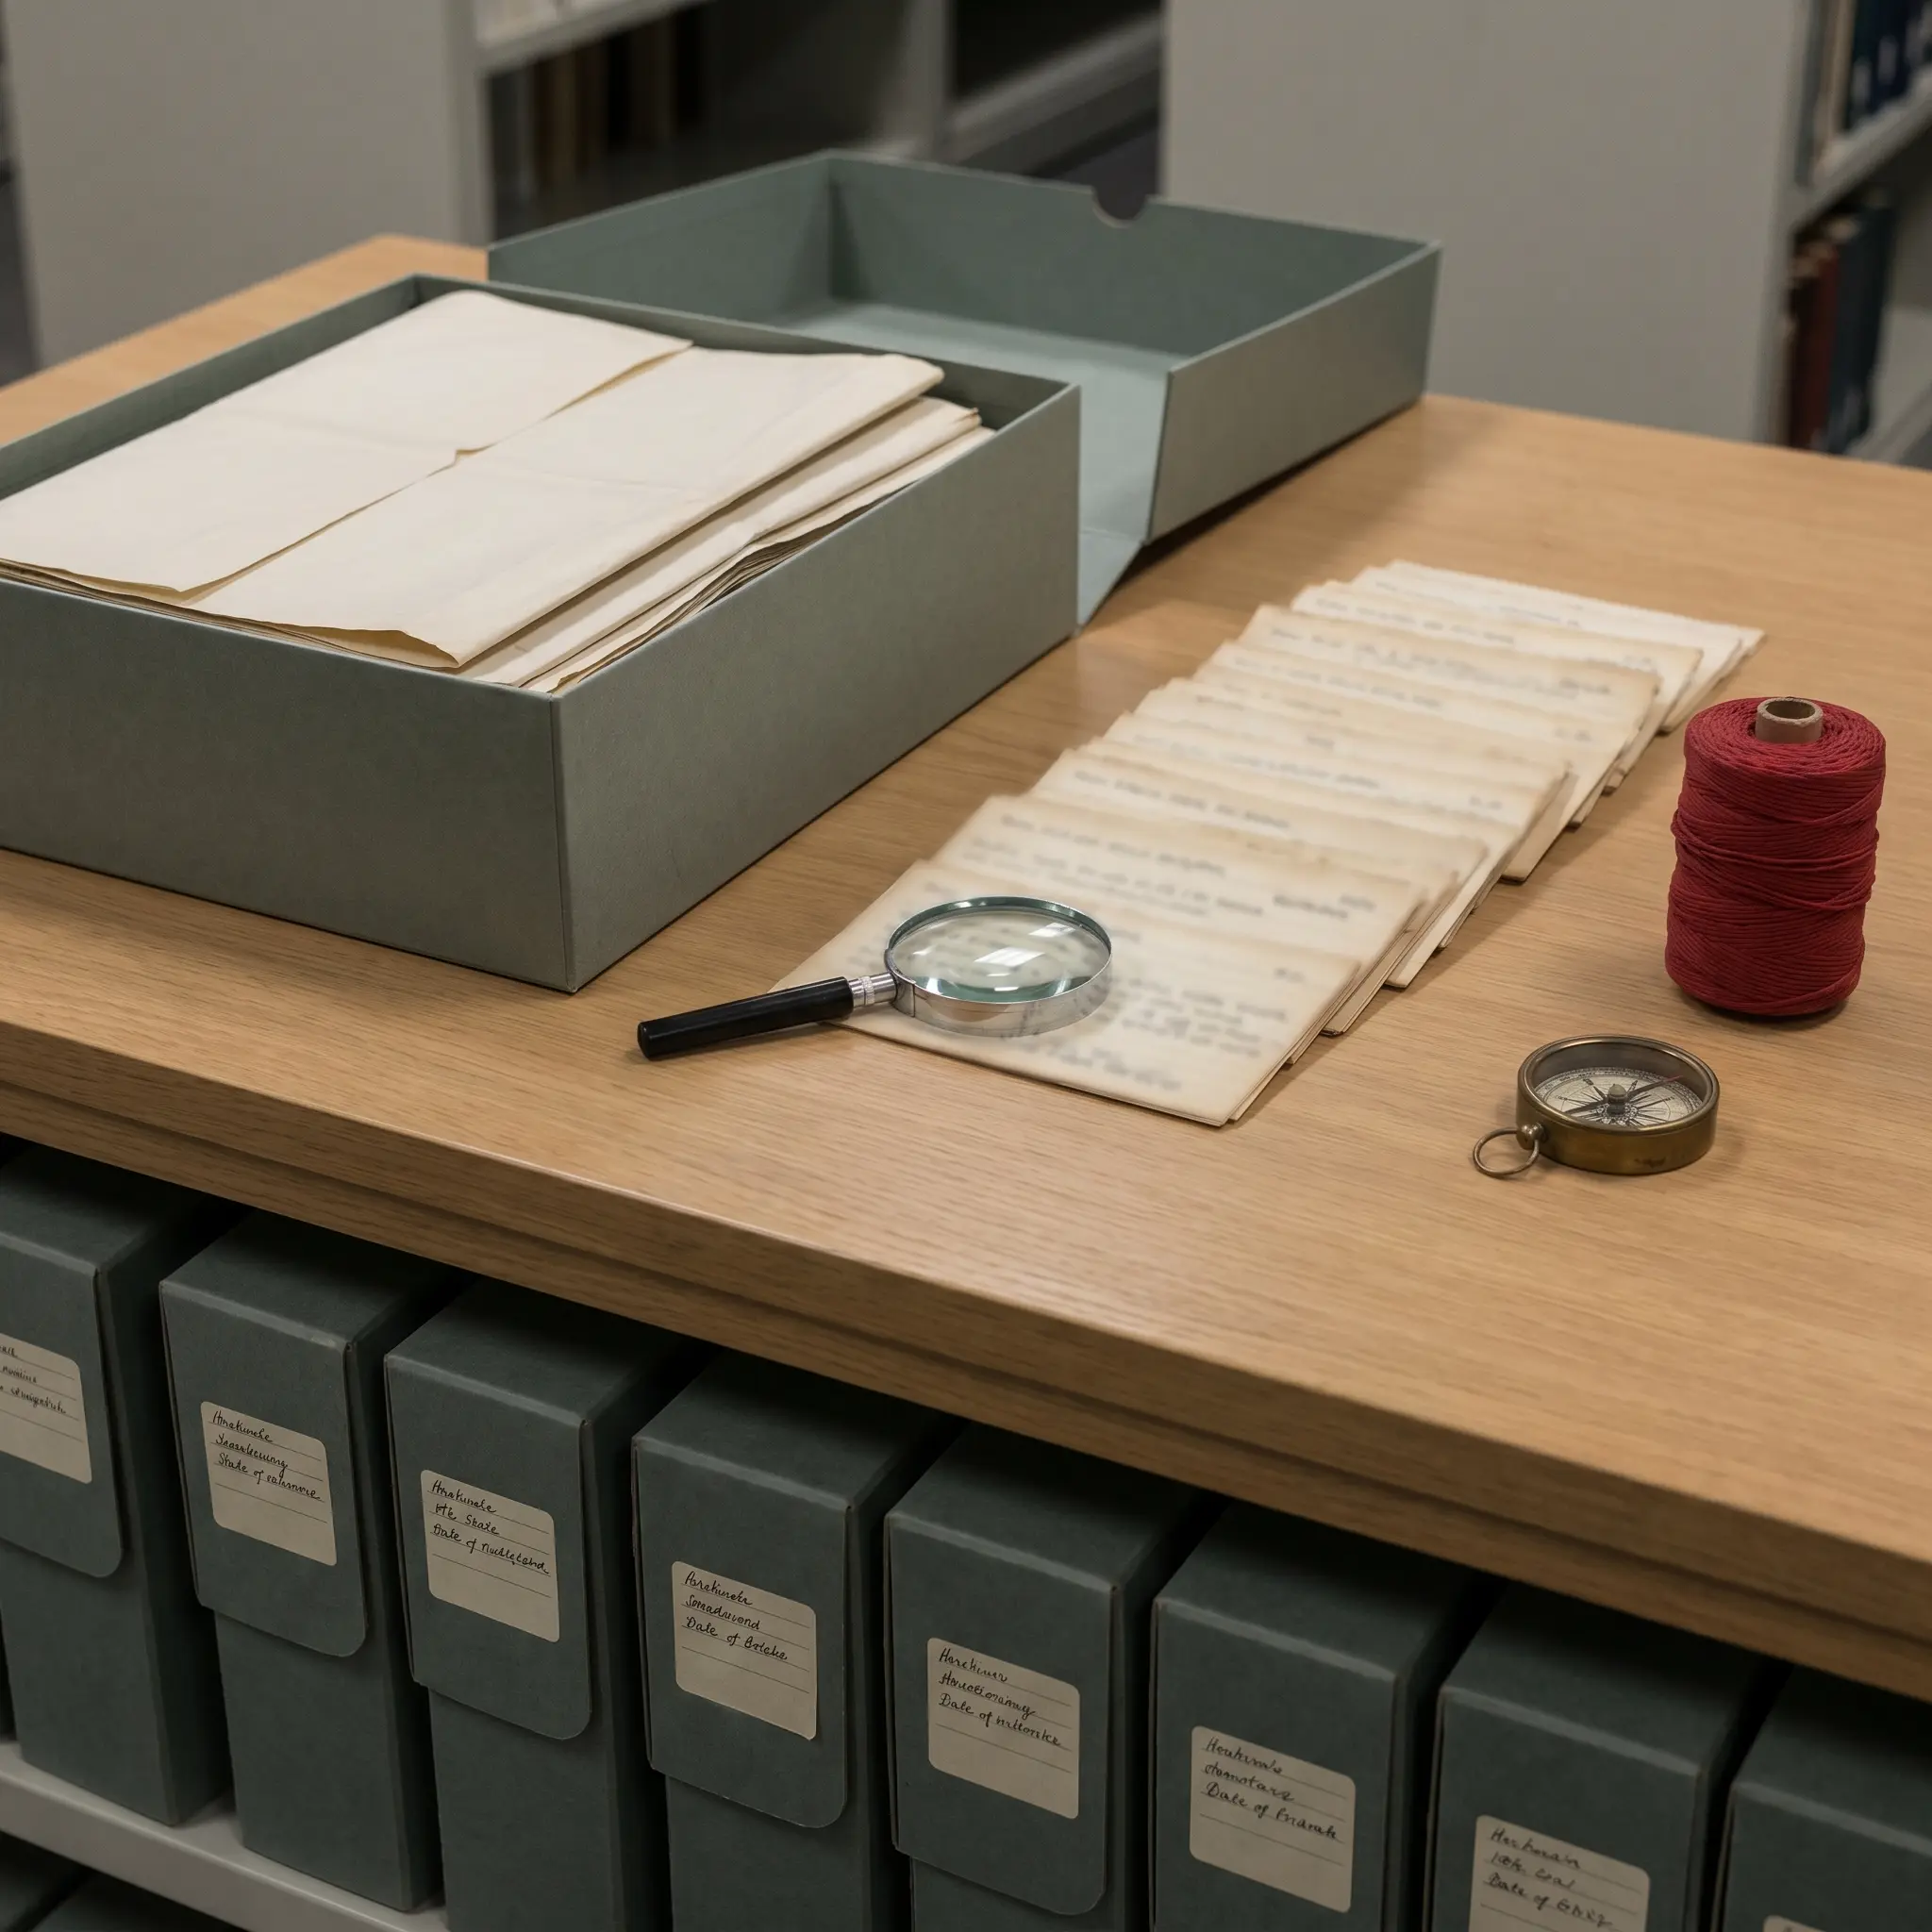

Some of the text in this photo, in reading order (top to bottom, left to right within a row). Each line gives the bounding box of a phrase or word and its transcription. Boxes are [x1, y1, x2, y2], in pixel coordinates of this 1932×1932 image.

[686, 1615, 719, 1637] Date
[725, 1633, 741, 1647] of
[938, 1691, 974, 1715] Date
[978, 1710, 993, 1728] of
[1206, 1780, 1249, 1808] Date
[1253, 1803, 1270, 1819] of
